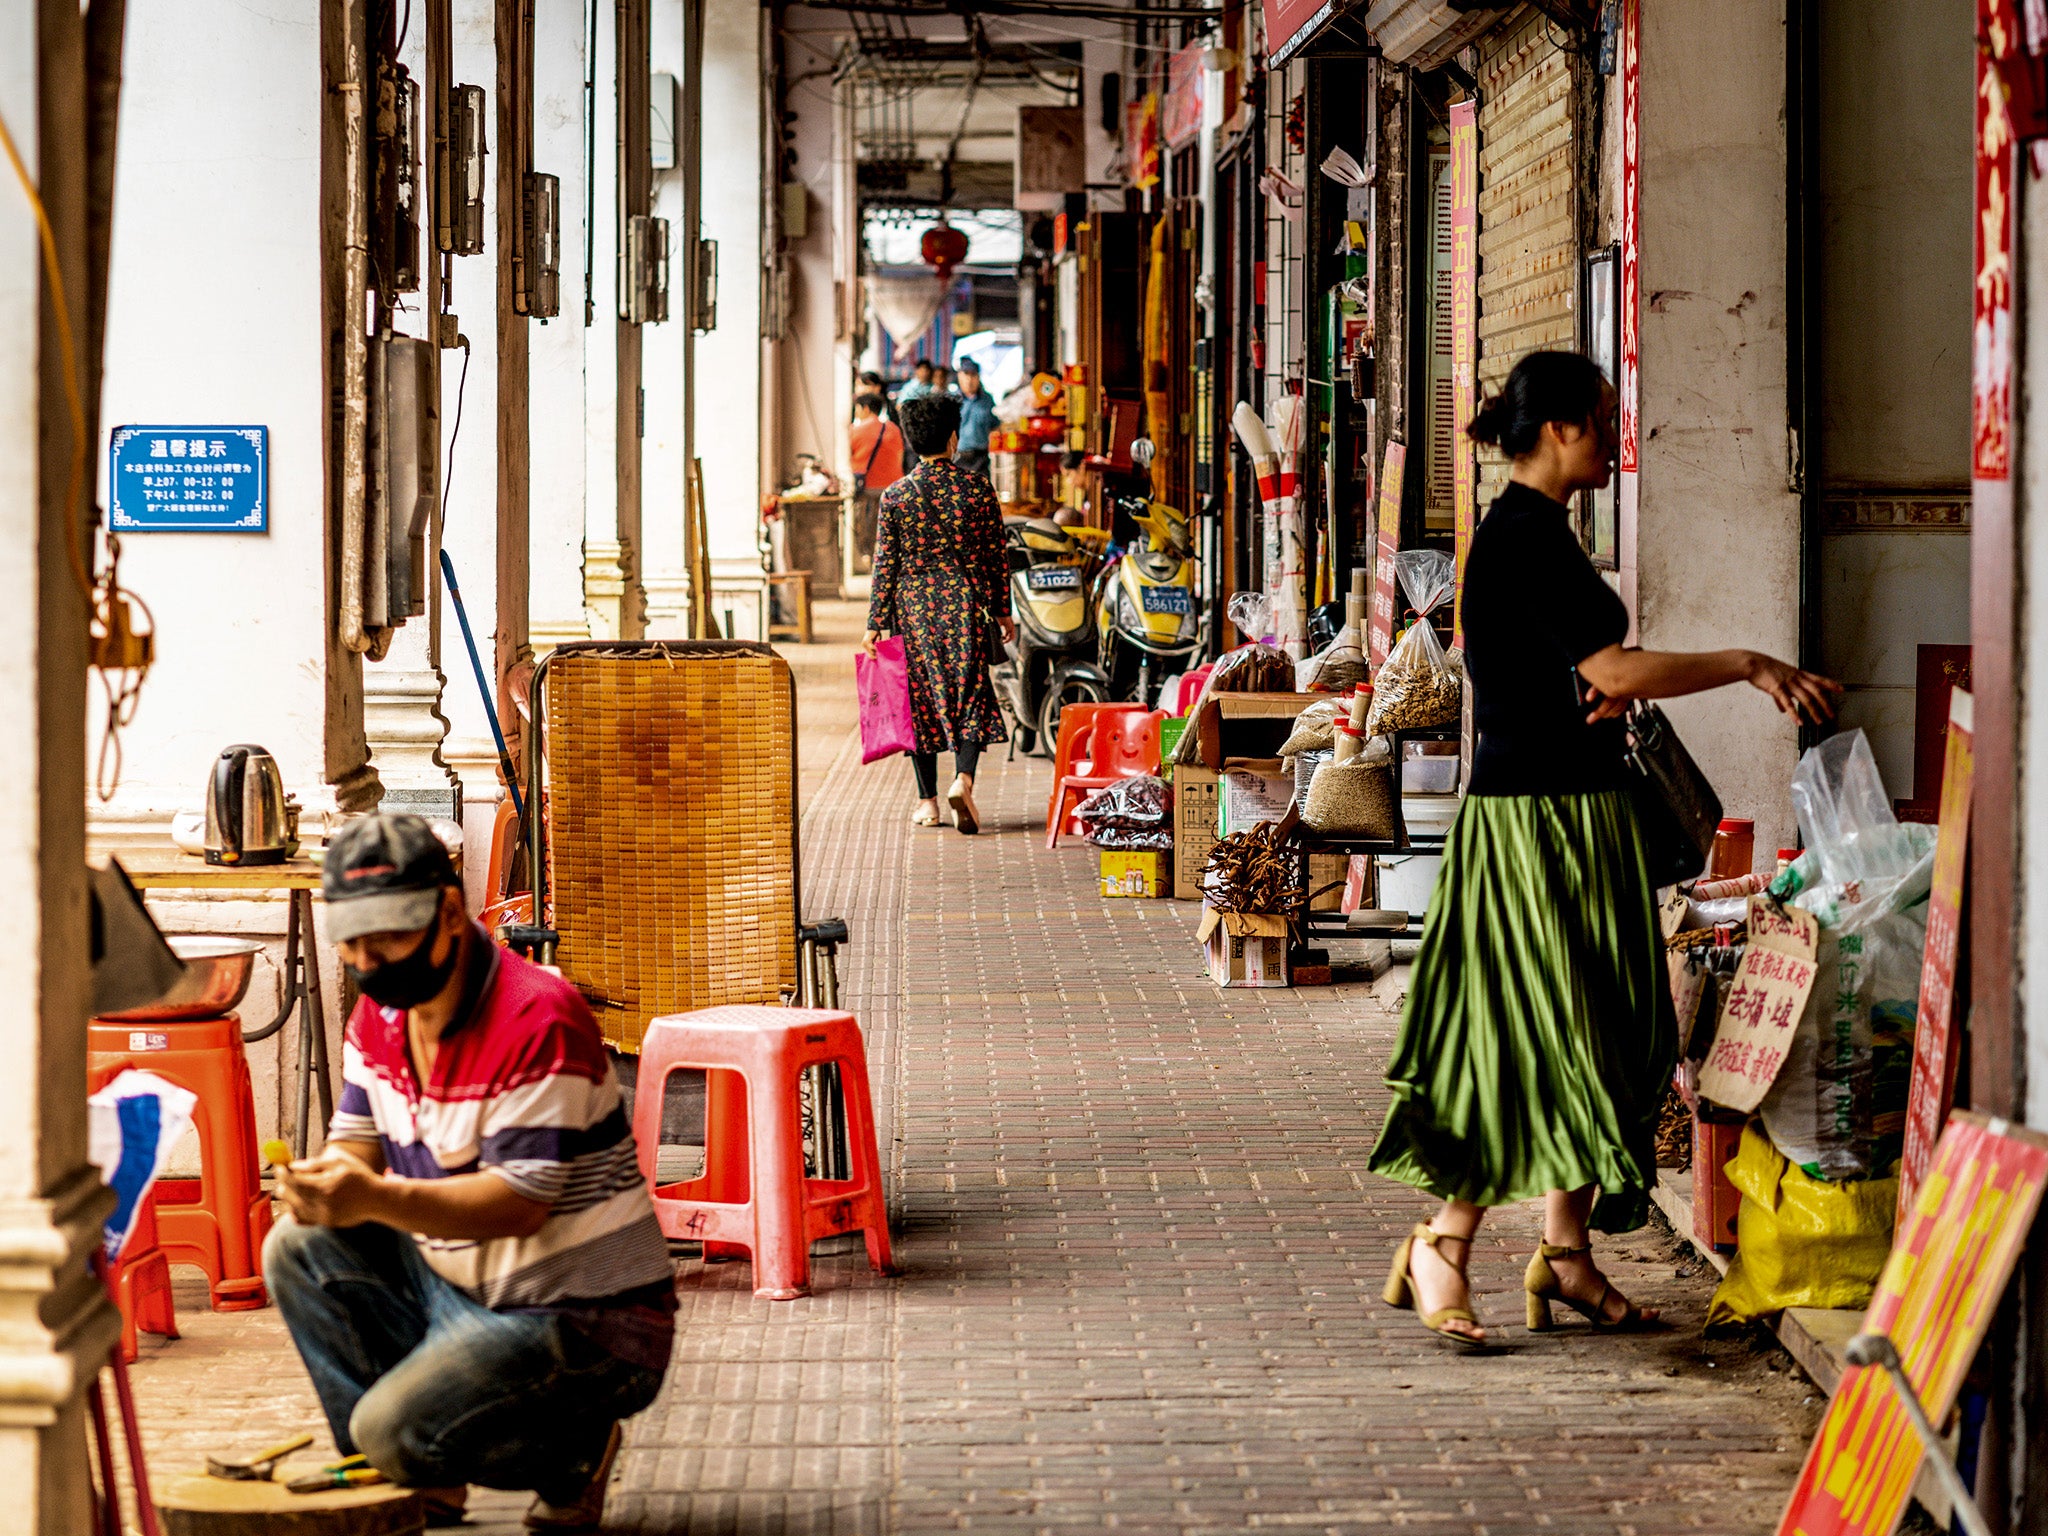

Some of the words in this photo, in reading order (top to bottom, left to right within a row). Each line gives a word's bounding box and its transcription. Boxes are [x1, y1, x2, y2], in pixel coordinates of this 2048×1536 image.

[150, 439, 227, 458] 温馨提示
[1145, 597, 1188, 612] 586127
